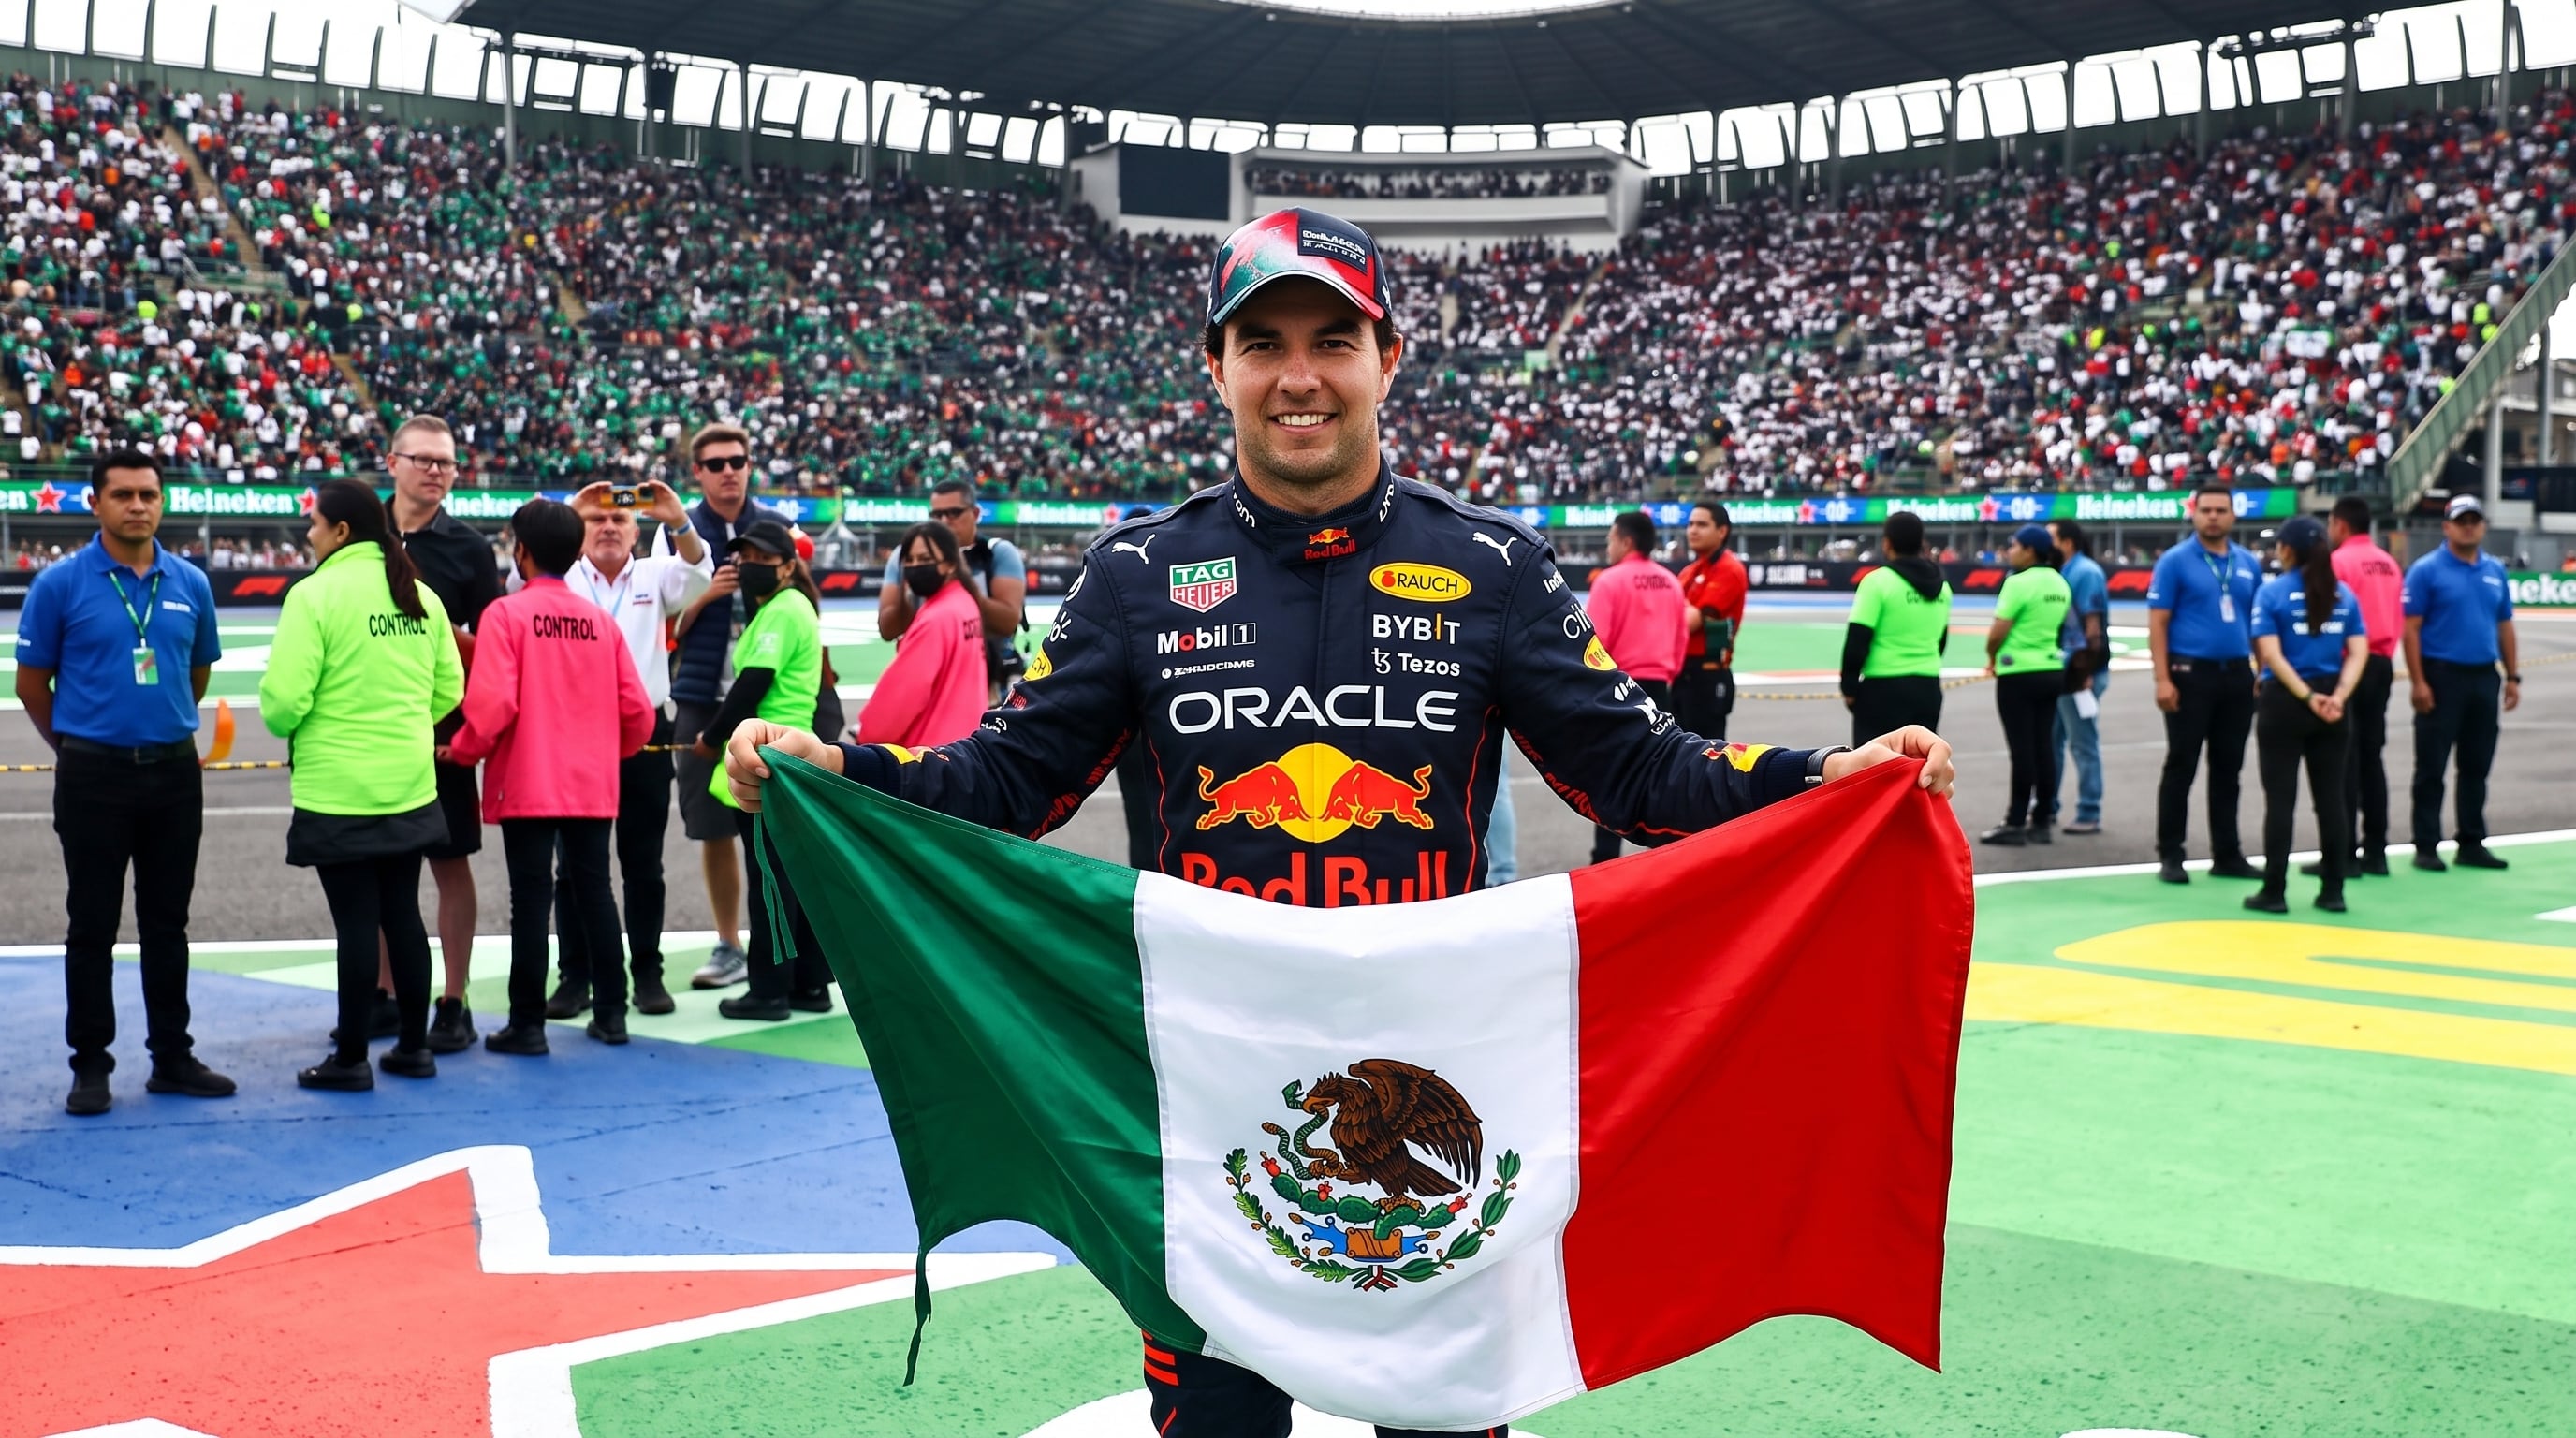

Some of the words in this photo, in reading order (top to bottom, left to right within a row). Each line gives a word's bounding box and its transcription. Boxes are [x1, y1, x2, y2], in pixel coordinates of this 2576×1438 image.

[169, 486, 294, 514] Heineken
[2075, 494, 2178, 520] Heineken
[1175, 562, 1229, 583] TAG
[1397, 572, 1458, 594] RAUCH
[1174, 580, 1233, 608] HEUER
[369, 613, 427, 638] CONTROL
[533, 614, 598, 641] CONTROL
[1157, 624, 1228, 654] Mobil
[1397, 653, 1460, 677] Tezos
[1170, 685, 1459, 734] ORACLE
